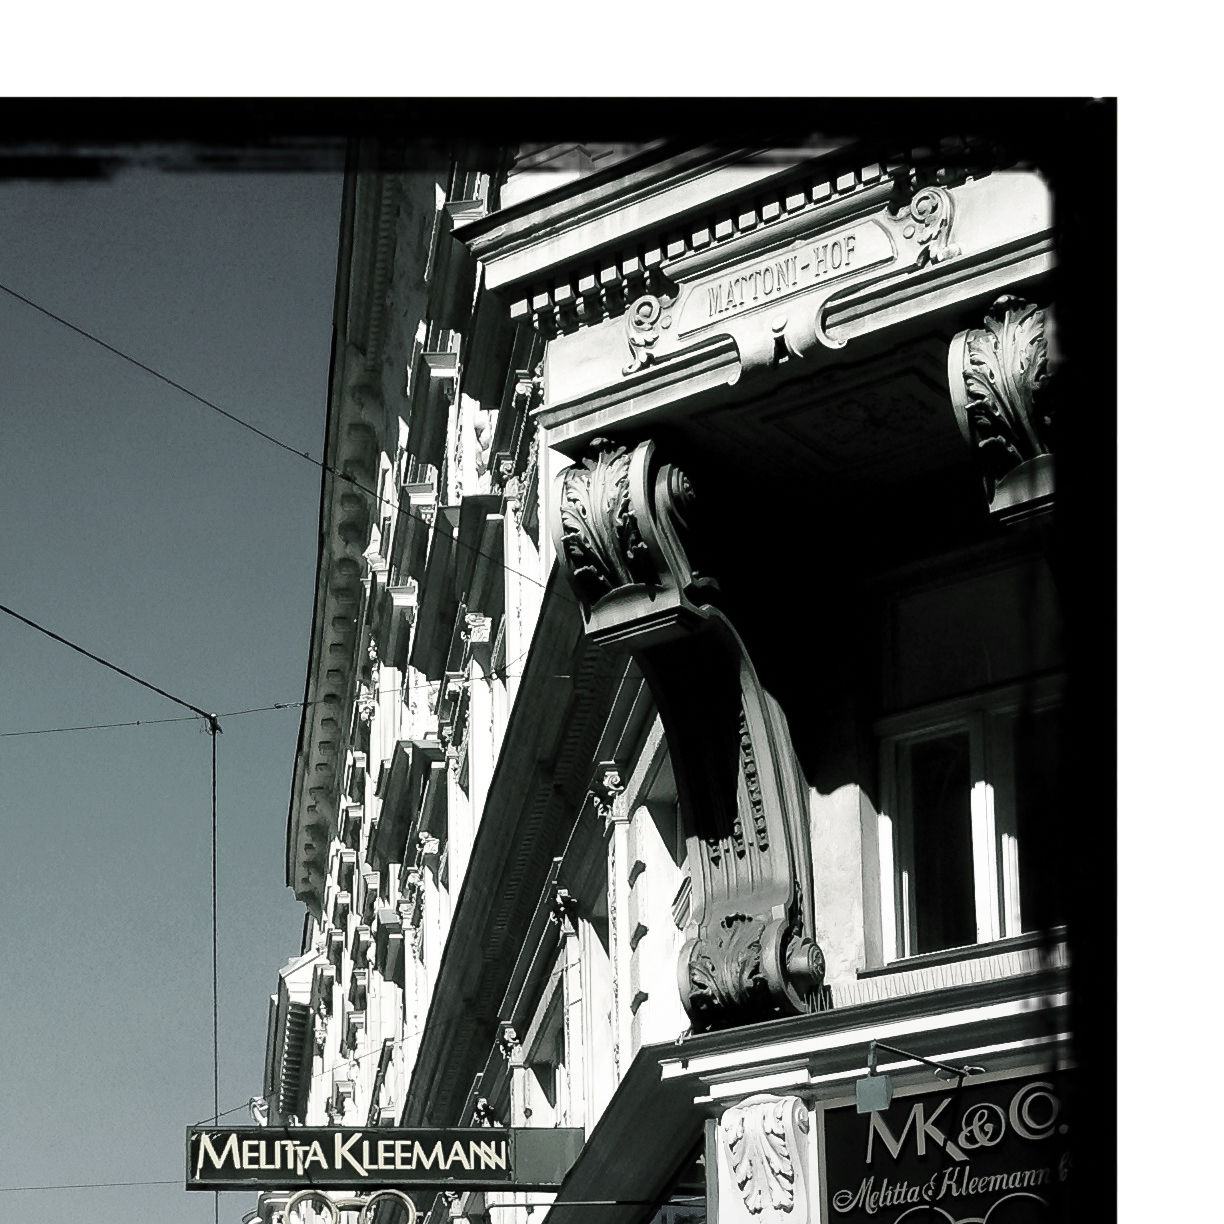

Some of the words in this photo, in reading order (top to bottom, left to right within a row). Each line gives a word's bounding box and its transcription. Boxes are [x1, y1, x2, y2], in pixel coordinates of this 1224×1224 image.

[707, 235, 857, 317] MATTONI-HOF
[194, 1132, 329, 1180] MELITTA
[333, 1132, 507, 1177] KLEEMANN
[832, 1174, 922, 1215] Melitta
